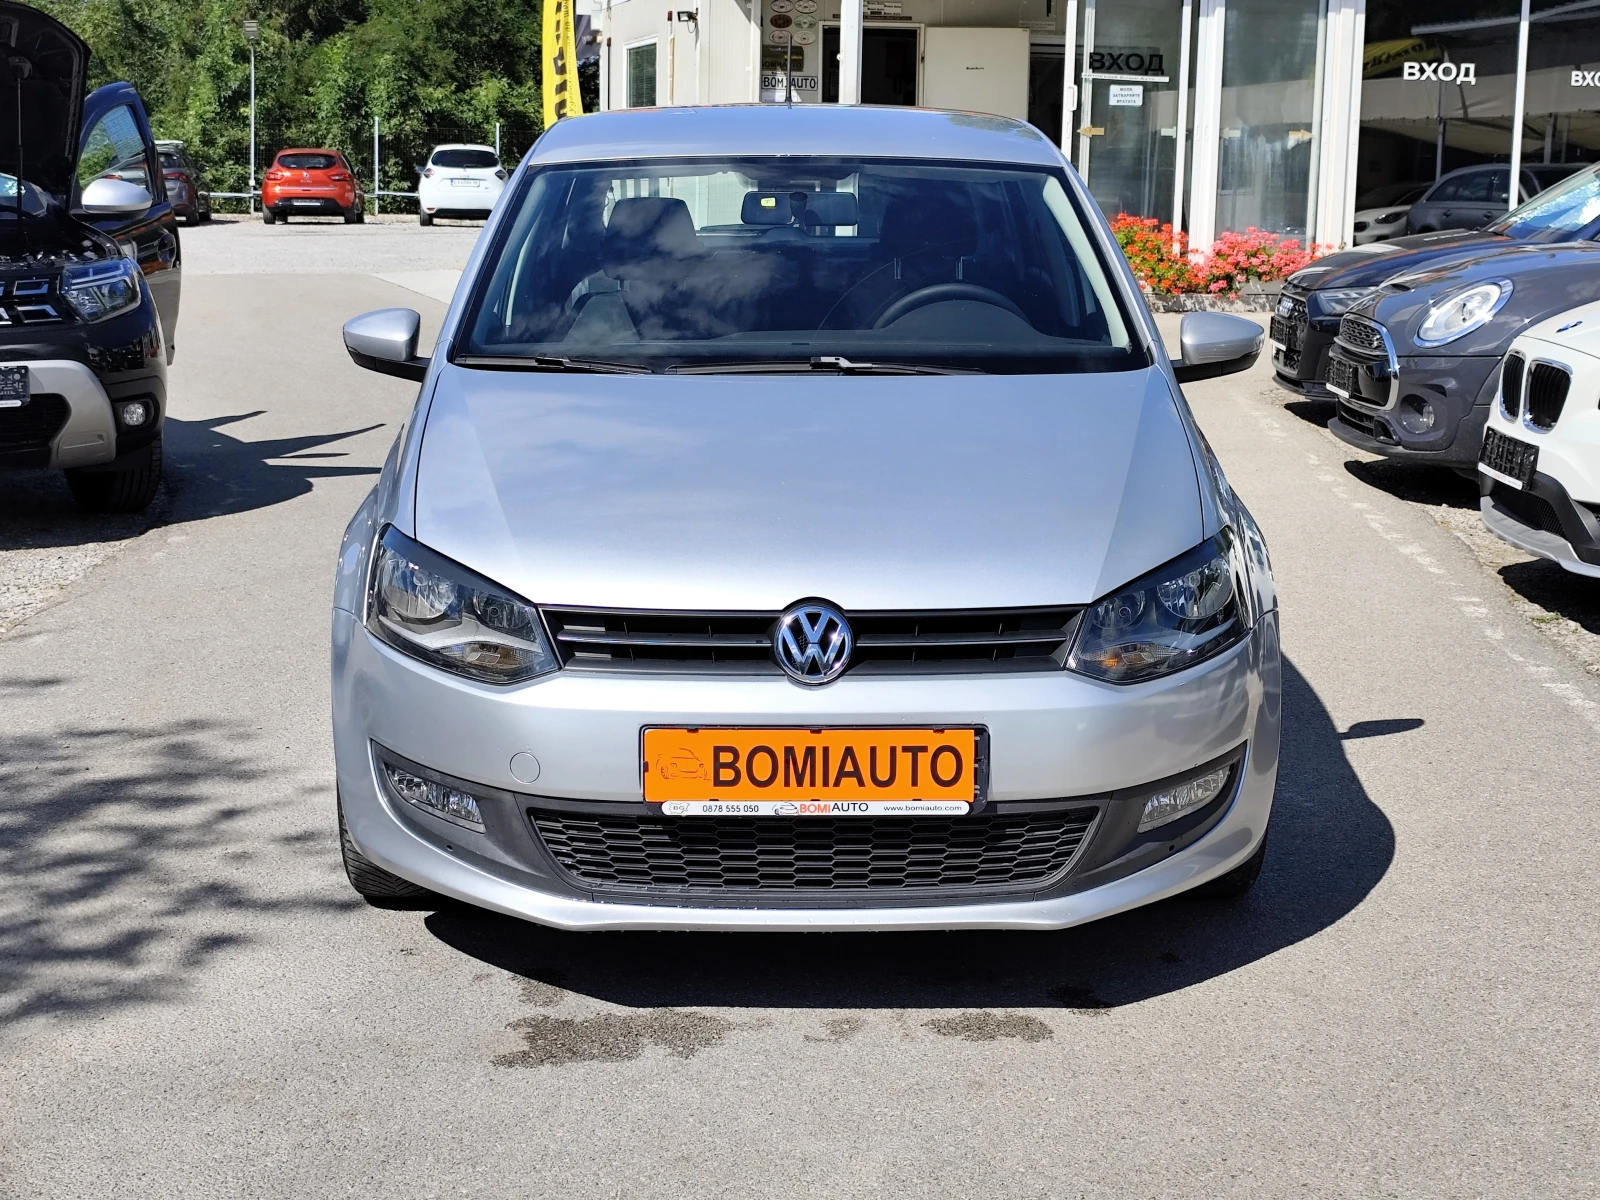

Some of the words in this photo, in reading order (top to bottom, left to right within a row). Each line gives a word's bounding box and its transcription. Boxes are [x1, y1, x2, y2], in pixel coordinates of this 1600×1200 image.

[1089, 52, 1165, 75] ВХОД
[1403, 61, 1476, 85] ВХОД
[712, 744, 964, 788] BOMIAUTO
[702, 804, 724, 813] 0878
[725, 804, 741, 813] 555
[743, 804, 759, 813] 050
[799, 802, 869, 814] BOMIAUTO
[883, 804, 962, 812] www.bomiauto.com
